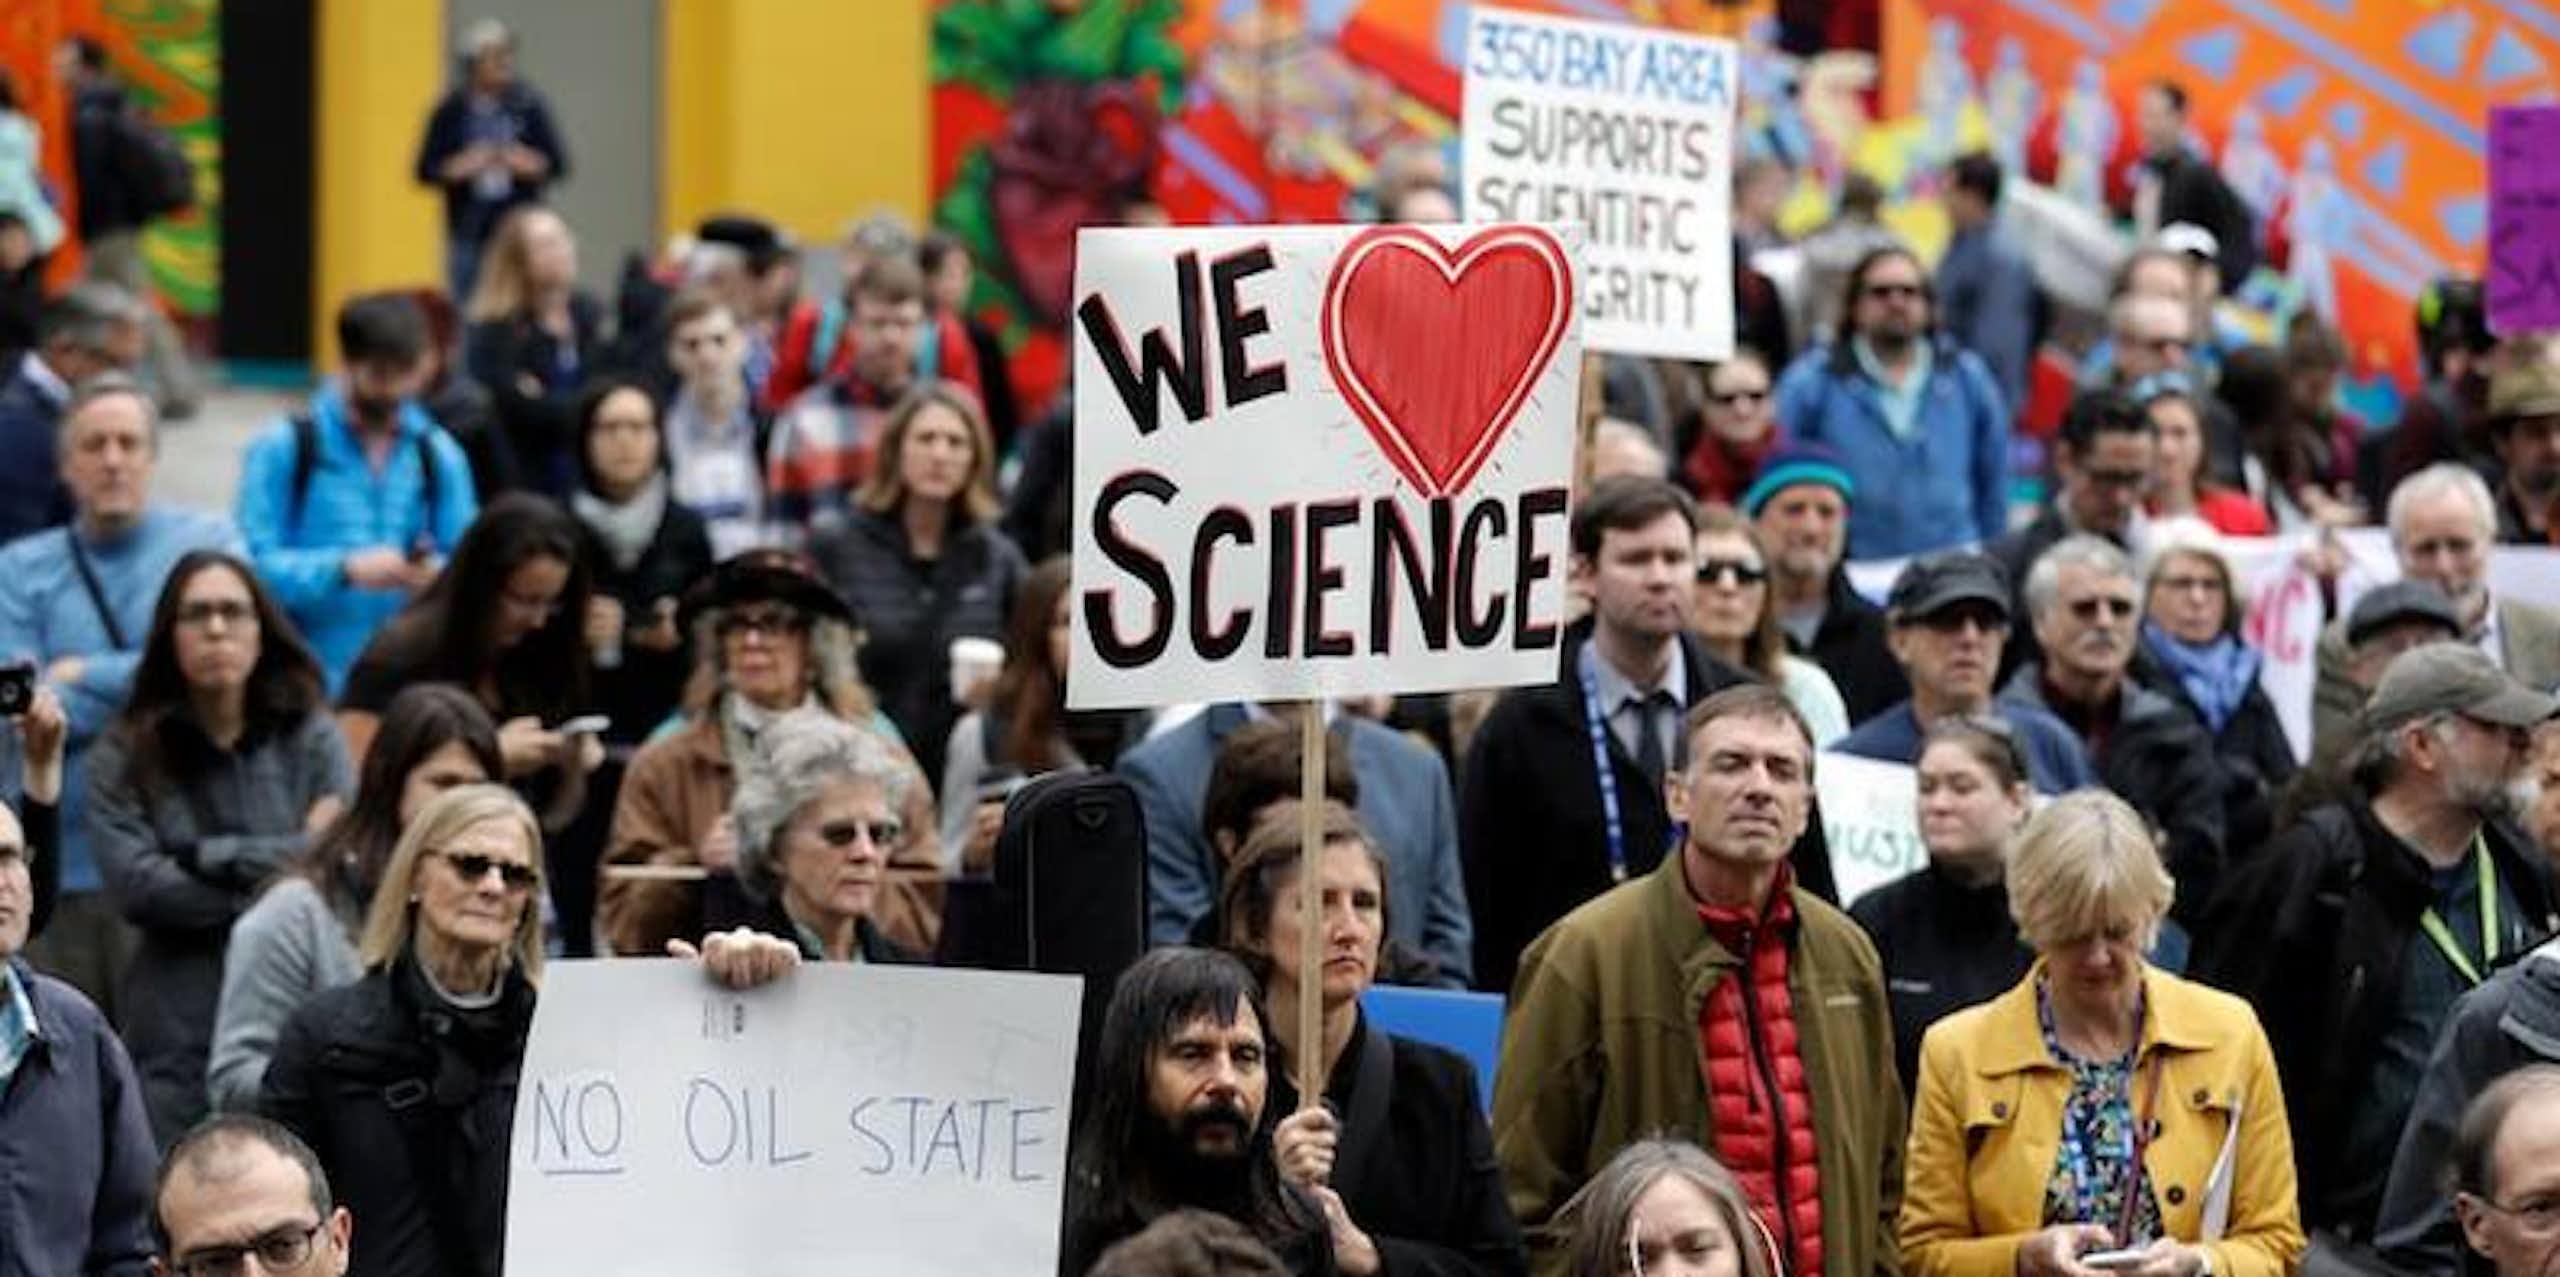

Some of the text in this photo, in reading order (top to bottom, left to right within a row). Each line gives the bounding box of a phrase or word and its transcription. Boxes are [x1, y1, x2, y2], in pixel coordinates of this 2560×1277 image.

[1475, 21, 1730, 106] 350 BAY AREA
[1488, 98, 1710, 181] SUPPORTS
[1078, 241, 1288, 436] WE
[1586, 266, 1698, 328] GRITY
[1083, 469, 1569, 669] SCIENCE
[531, 1077, 1058, 1183] NO OIL STATE
